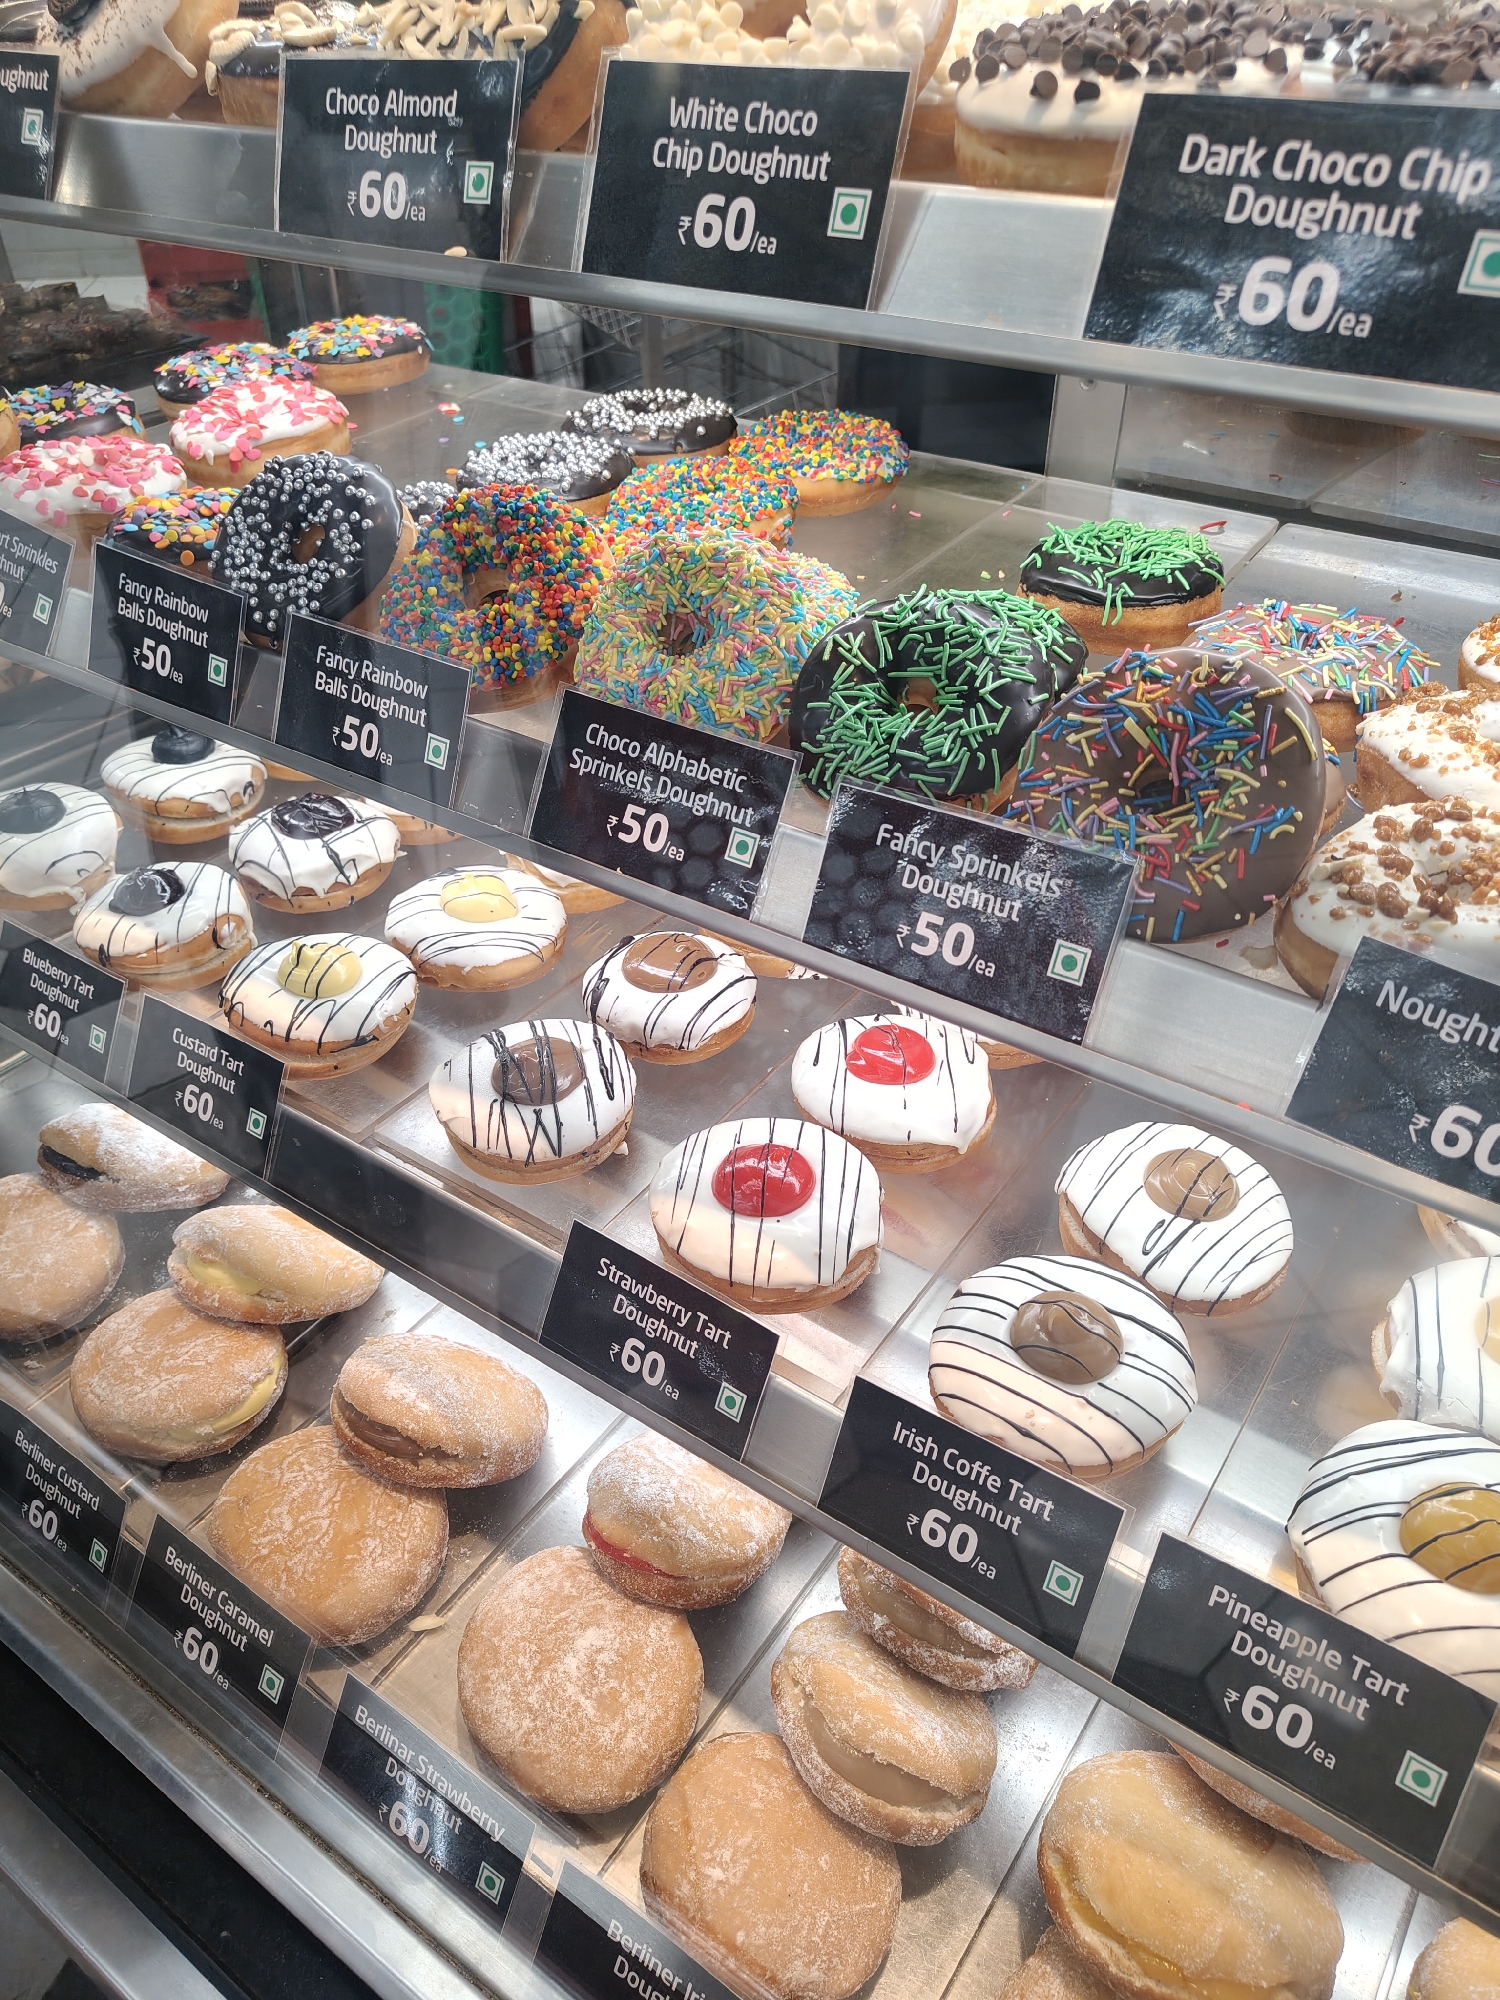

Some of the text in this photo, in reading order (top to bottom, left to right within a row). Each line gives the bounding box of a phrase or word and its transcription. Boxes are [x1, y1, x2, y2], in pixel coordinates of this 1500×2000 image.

[325, 87, 457, 118] Choco Almond
[669, 96, 818, 137] White Choco
[344, 124, 438, 159] Doughnut
[652, 137, 831, 185] Chip Doughnut
[1178, 133, 1492, 204] Dark Choco Chip
[1223, 183, 1423, 240] Doughnut
[0, 553, 25, 581] hnut
[10, 536, 59, 575] Sprinkles
[118, 573, 209, 624] Fancy Rainbow
[118, 597, 209, 649] Balls Doughnut
[314, 670, 428, 728] Balls Doughnut
[316, 645, 429, 700] Fancy Rainbow
[569, 747, 754, 827] Sprinkels Doughnut
[585, 723, 748, 793] Choco Alphabetic
[876, 823, 1065, 899] Fancy Sprinkels
[901, 863, 1023, 922] Doughnut
[22, 948, 95, 1000] Blueberry Tart
[30, 972, 80, 1013] Doughnut
[172, 1027, 245, 1076] Custard Tart
[176, 1051, 236, 1095] Doughnut
[597, 1257, 732, 1350] Strawberry Tart
[612, 1293, 699, 1359] Doughnut
[15, 1429, 100, 1512] Berliner Custard
[25, 1463, 82, 1520] Doughnut
[892, 1421, 1055, 1522] Irish Coffe Tart
[911, 1461, 1023, 1536] Doughnut
[164, 1545, 274, 1648] Berliner Caramel
[180, 1585, 249, 1652] Doughnut
[1207, 1584, 1410, 1707] Pineapple Tart
[1230, 1629, 1371, 1722] Doughnut
[354, 1704, 507, 1843] Berlinar Strawberry
[385, 1756, 463, 1835] Doughnut
[607, 1919, 683, 1992] Berliner
